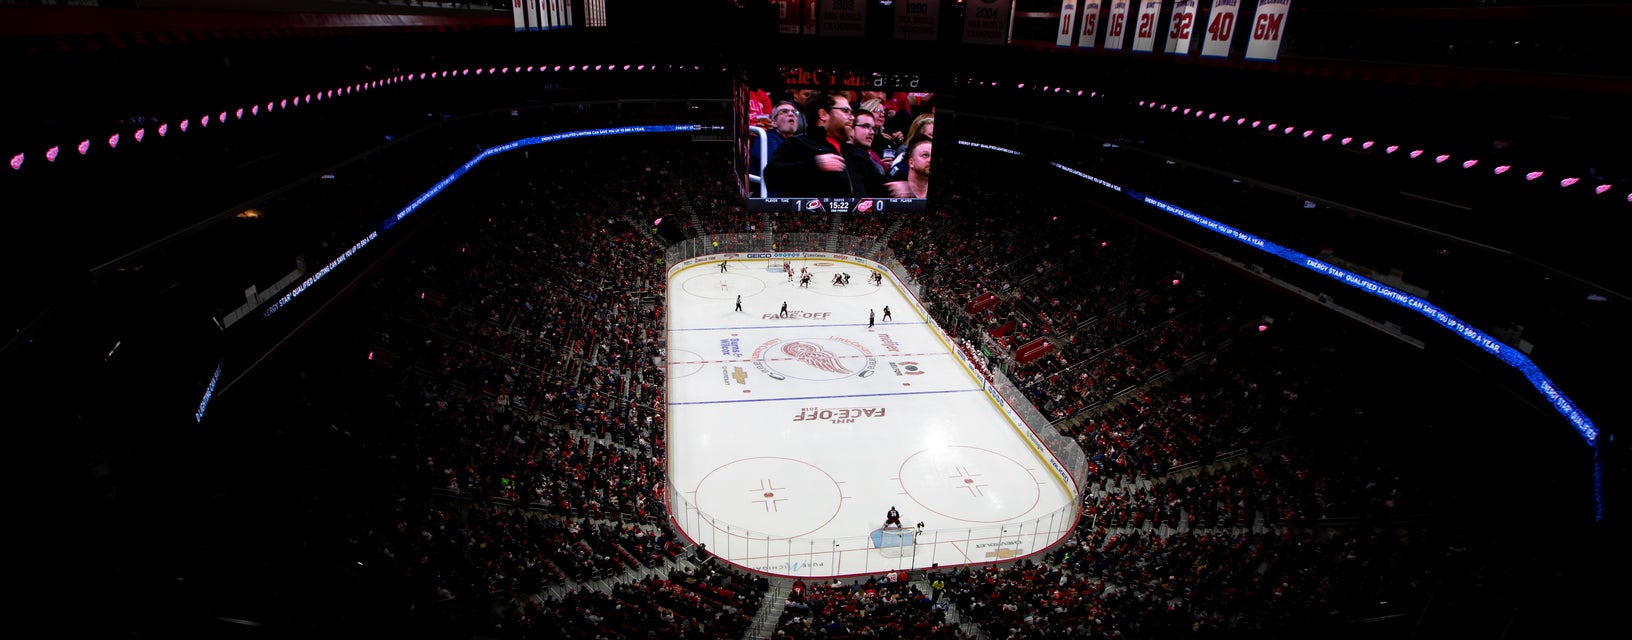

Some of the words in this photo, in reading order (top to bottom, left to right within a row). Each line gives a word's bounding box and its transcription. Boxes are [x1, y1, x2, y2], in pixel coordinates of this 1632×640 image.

[976, 8, 998, 18] 2004
[1062, 14, 1070, 34] 11
[1083, 14, 1096, 36] 15
[1110, 14, 1124, 36] 16
[1138, 14, 1154, 38] 21
[1170, 12, 1192, 39] 32
[1208, 12, 1234, 41] 40
[1254, 14, 1284, 40] GM
[796, 200, 801, 211] 1
[876, 200, 883, 211] 0
[1166, 205, 1183, 216] QUALIFIED
[1184, 212, 1200, 222] LIGHTING
[1208, 221, 1218, 230] SAVE
[292, 277, 313, 297] QUALIFIED
[313, 265, 330, 282] LIGHTING
[329, 260, 338, 270] CAN
[337, 253, 346, 264] SAVE
[351, 245, 357, 253] UP
[1307, 260, 1328, 272] ENERGY
[1345, 275, 1378, 291] QUALIFIED
[1378, 286, 1408, 302] LIGHTING
[1408, 298, 1422, 309] CAN
[1423, 305, 1437, 316] SAVE
[1437, 311, 1448, 323] YOU
[1448, 318, 1456, 327] UP
[1456, 322, 1464, 332] TO
[762, 312, 832, 320] FACE-OFF
[720, 338, 730, 355] Wilcox
[730, 338, 740, 352] Burns
[793, 408, 886, 421] FACE-OFF
[1050, 458, 1068, 483] FALKEN
